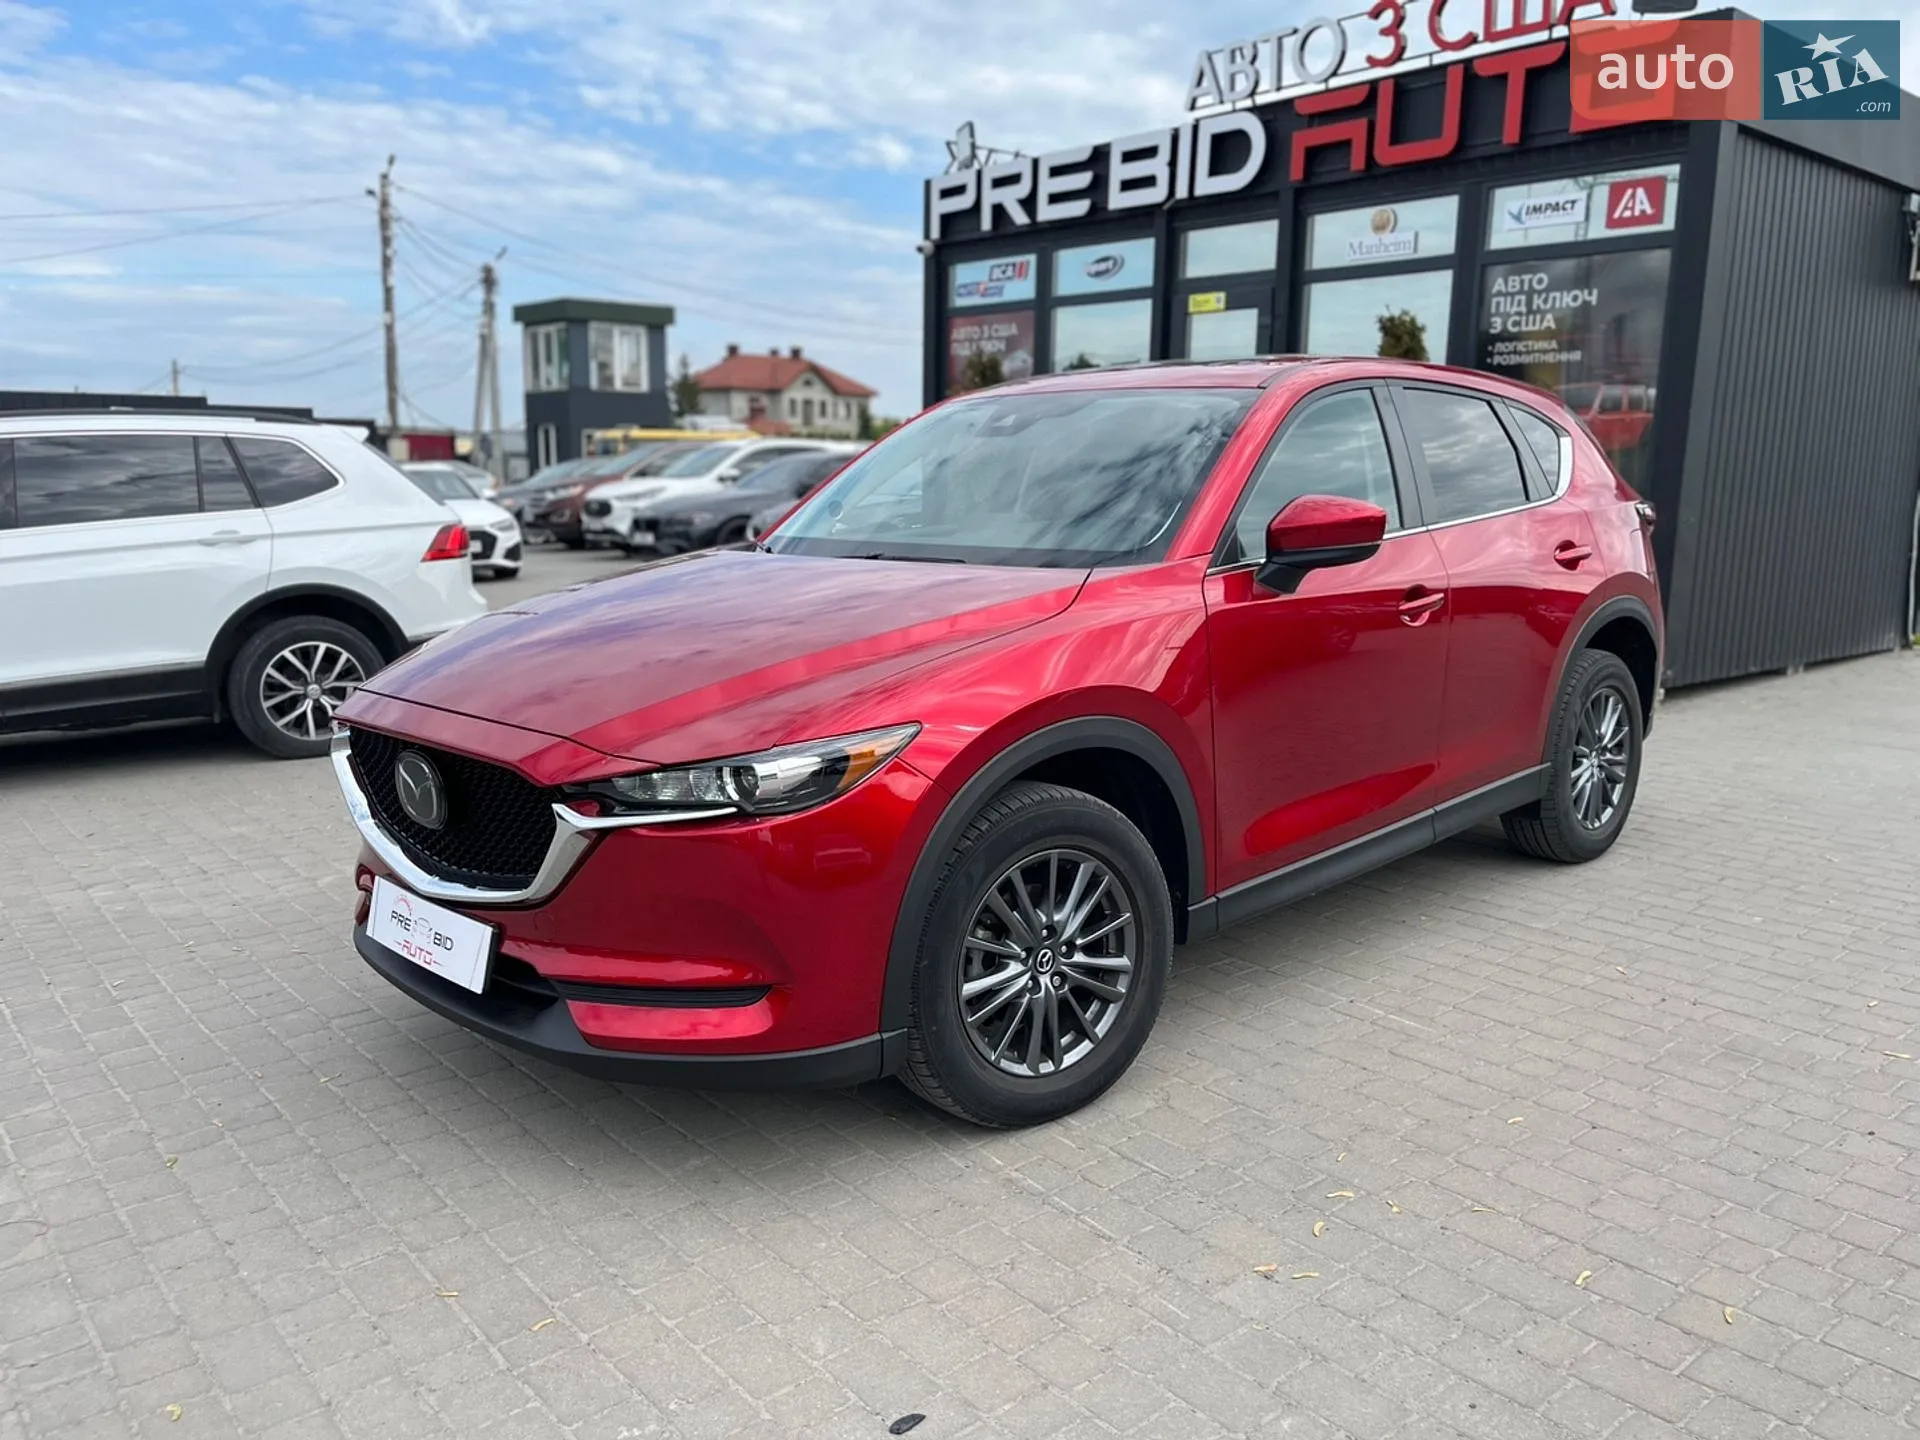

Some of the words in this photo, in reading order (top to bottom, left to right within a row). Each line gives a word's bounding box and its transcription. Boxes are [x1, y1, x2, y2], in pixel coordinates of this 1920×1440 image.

[1183, 16, 1347, 110] АВТО
[926, 145, 1096, 240] PRE
[1107, 110, 1267, 212] BID
[1525, 199, 1578, 217] IMPACT
[1491, 273, 1549, 294] АВТО
[1490, 294, 1527, 313] ПІД
[1532, 288, 1598, 311] КЛЮЧ
[1507, 313, 1556, 333] США
[390, 910, 412, 932] PRE
[432, 931, 455, 952] BID
[400, 939, 434, 967] AUTO
